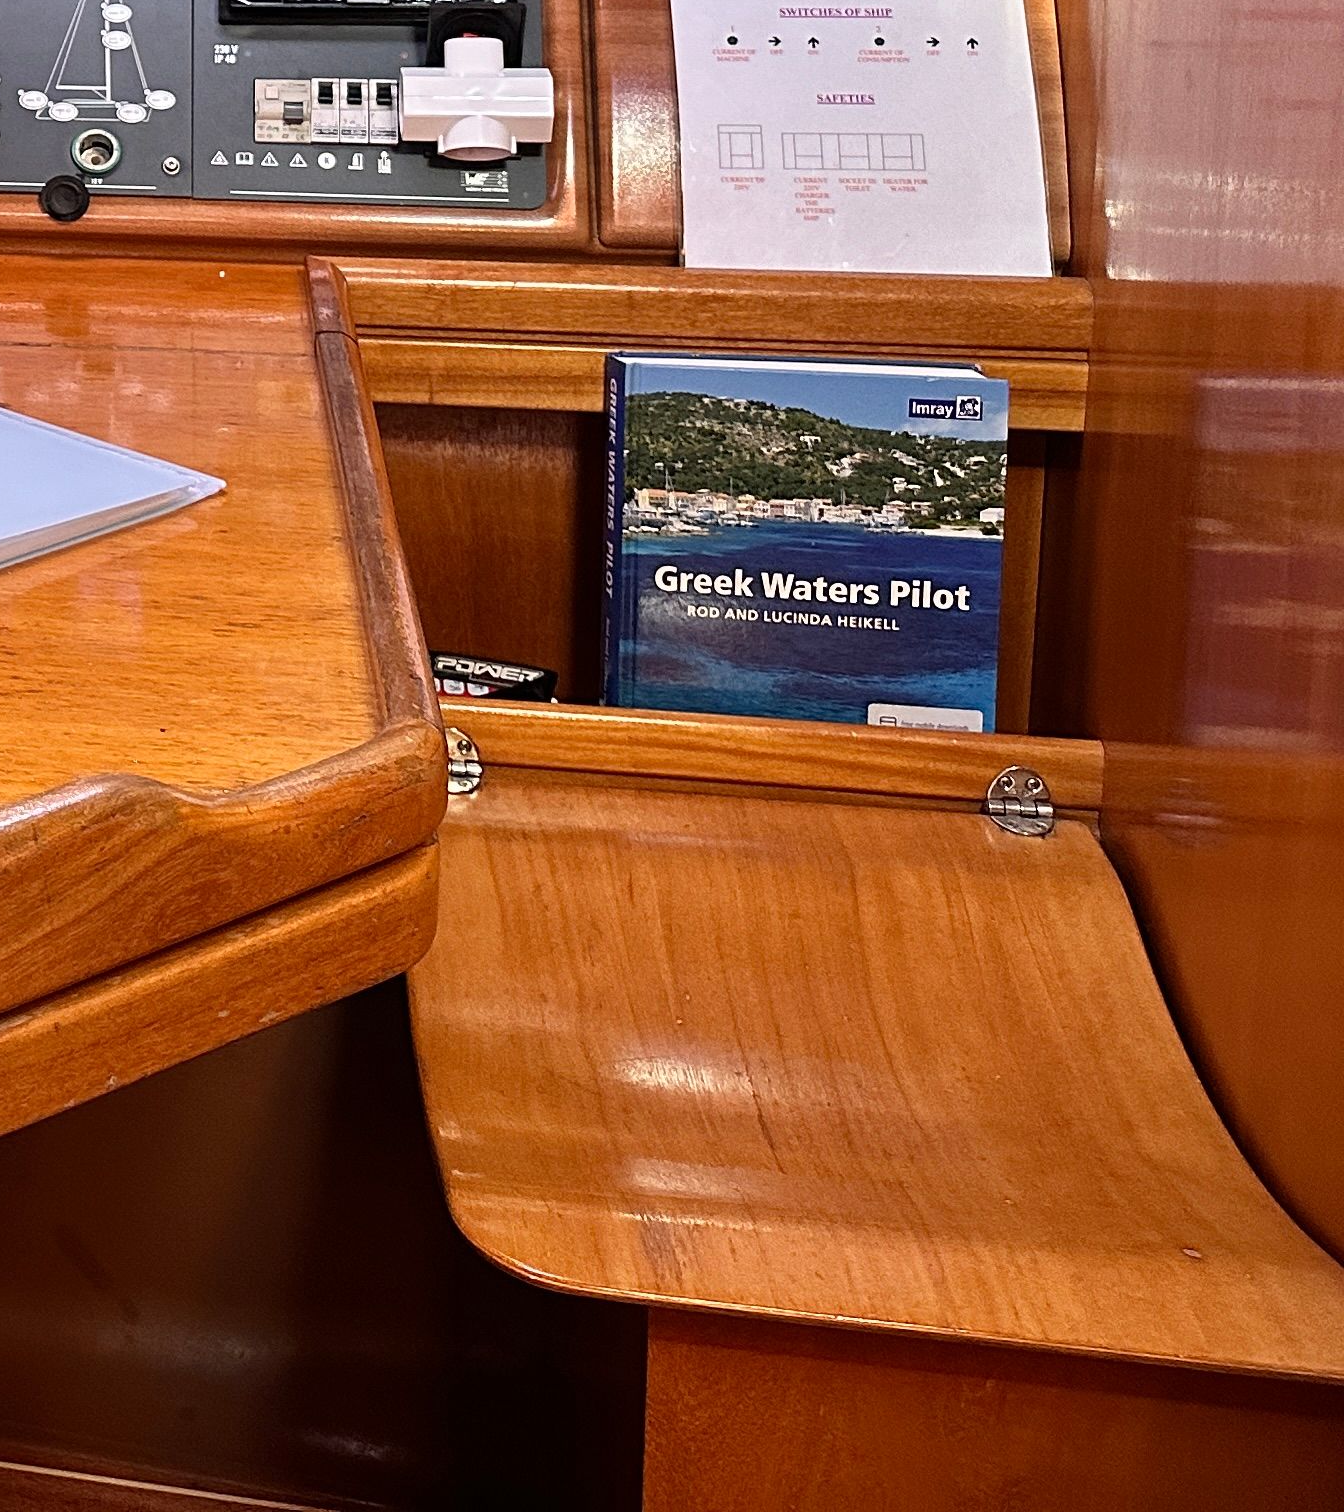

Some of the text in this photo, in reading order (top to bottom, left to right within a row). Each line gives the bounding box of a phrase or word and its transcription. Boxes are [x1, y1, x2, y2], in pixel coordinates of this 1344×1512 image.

[779, 7, 893, 18] SWITCHES OF SHIP
[816, 93, 875, 104] SAFETIES
[912, 401, 954, 418] Imray
[605, 378, 618, 599] GREEK WATERS PILOT
[654, 565, 971, 611] Greek Waters Pilot
[687, 605, 900, 630] ROD AND LUCINDA HEIKELL
[436, 656, 542, 683] POWER
